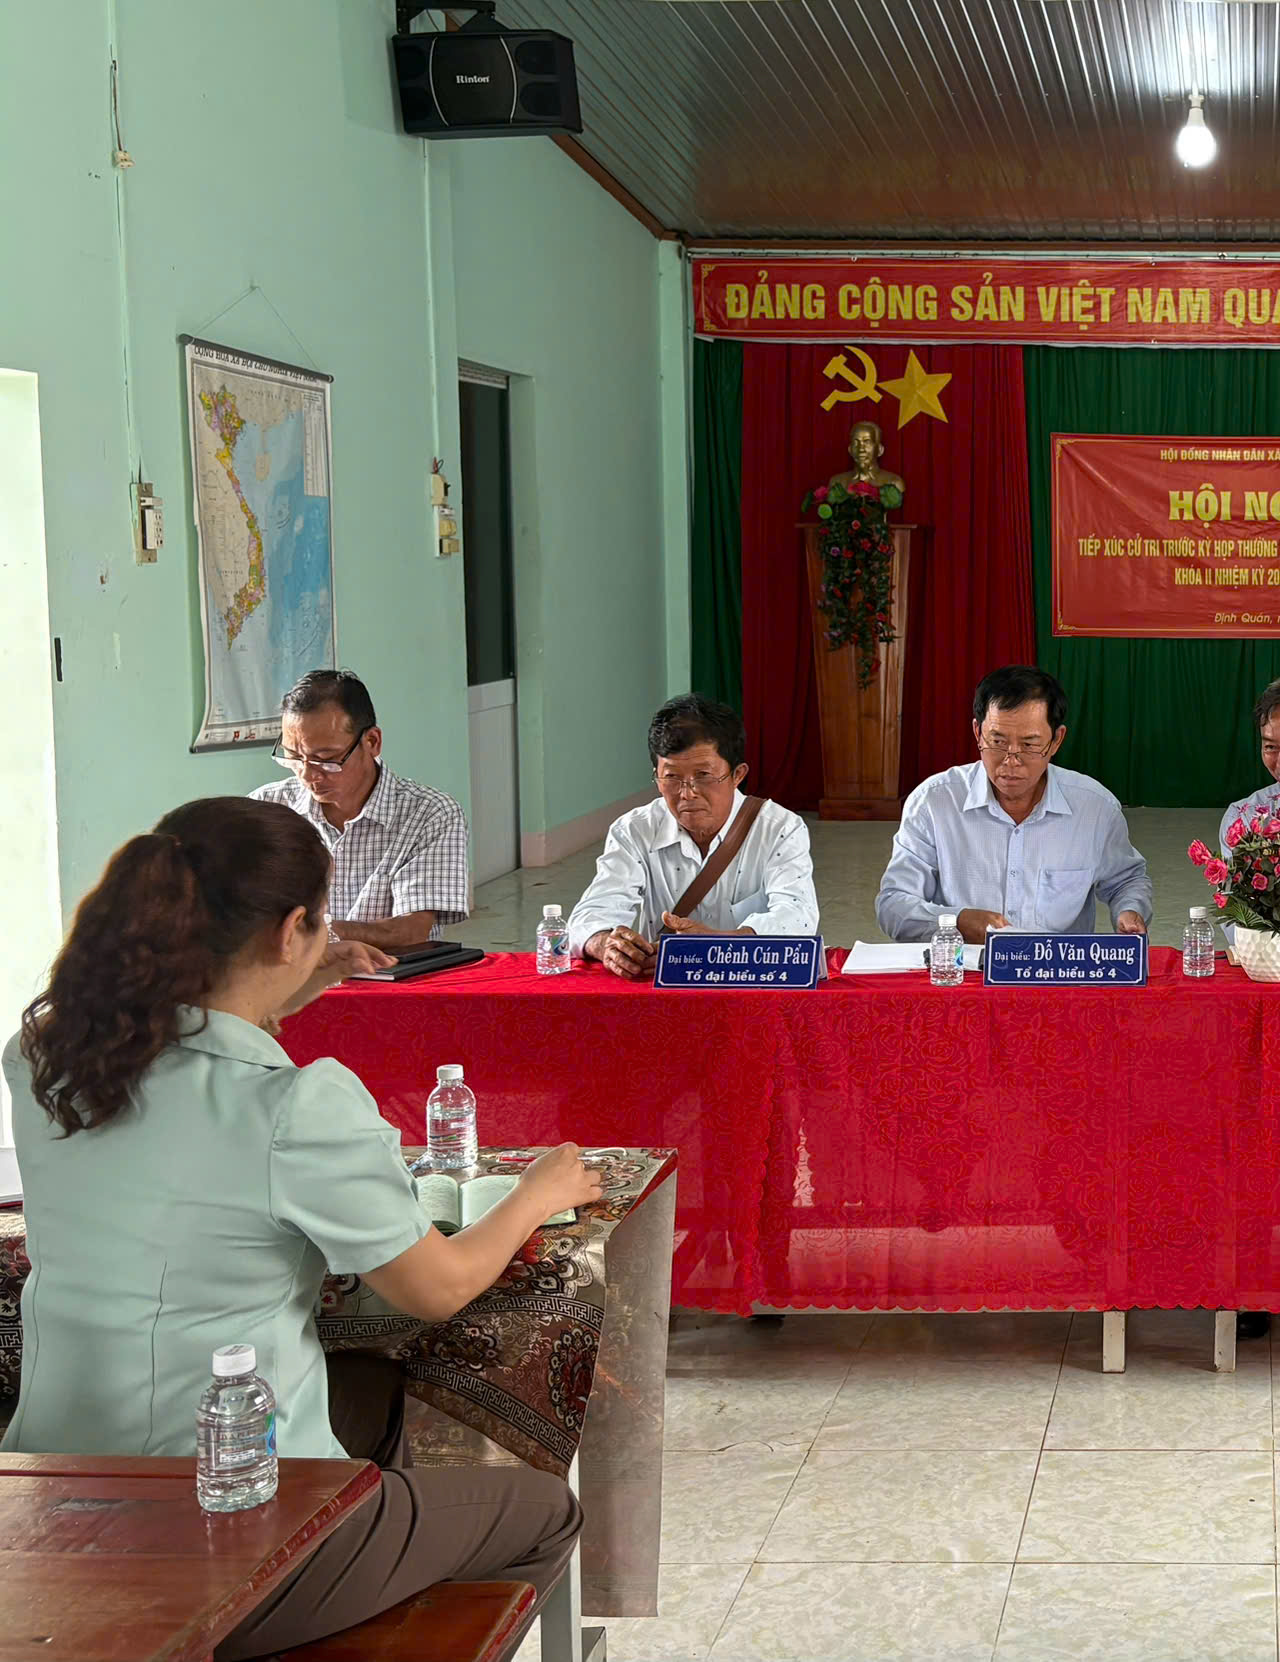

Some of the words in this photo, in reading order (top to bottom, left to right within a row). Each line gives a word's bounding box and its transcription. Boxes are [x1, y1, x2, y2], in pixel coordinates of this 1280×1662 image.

[456, 75, 490, 84] Rinton
[726, 271, 825, 320] ĐẢNG
[838, 277, 938, 328] CỘNG
[950, 272, 1025, 322] SẢN
[1037, 280, 1115, 330] VIỆT
[1127, 287, 1209, 324] NAM
[1160, 448, 1178, 463] HỘI
[1212, 448, 1240, 461] NHÂN
[1169, 483, 1232, 528] HỘI
[1079, 533, 1101, 556] TIẾP
[1104, 535, 1125, 556] XÚC
[1127, 533, 1142, 557] CỬ
[1144, 539, 1160, 557] TRI
[1162, 536, 1195, 557] TRƯỚC
[1214, 539, 1235, 561] HỌP
[1237, 536, 1277, 557] THƯỜNG
[1175, 564, 1203, 585] KHÓA
[1205, 568, 1212, 585] II
[1214, 565, 1249, 589] NHIỆM
[1215, 612, 1237, 625] Định
[1241, 612, 1272, 624] Quán,
[668, 954, 682, 964] Đại
[753, 945, 779, 964] Cún
[994, 951, 1008, 962] Đại
[1034, 939, 1053, 961] Đỗ
[1058, 942, 1085, 961] Văn
[1090, 942, 1135, 965] Quang
[685, 968, 703, 981] Tổ
[705, 970, 724, 983] đại
[728, 969, 756, 981] biểu
[760, 970, 776, 981] số
[779, 971, 787, 981] 4
[1014, 966, 1033, 978] Tổ
[1035, 968, 1054, 980] đại
[1058, 967, 1085, 978] biểu
[1089, 967, 1106, 978] số
[1107, 968, 1117, 978] 4
